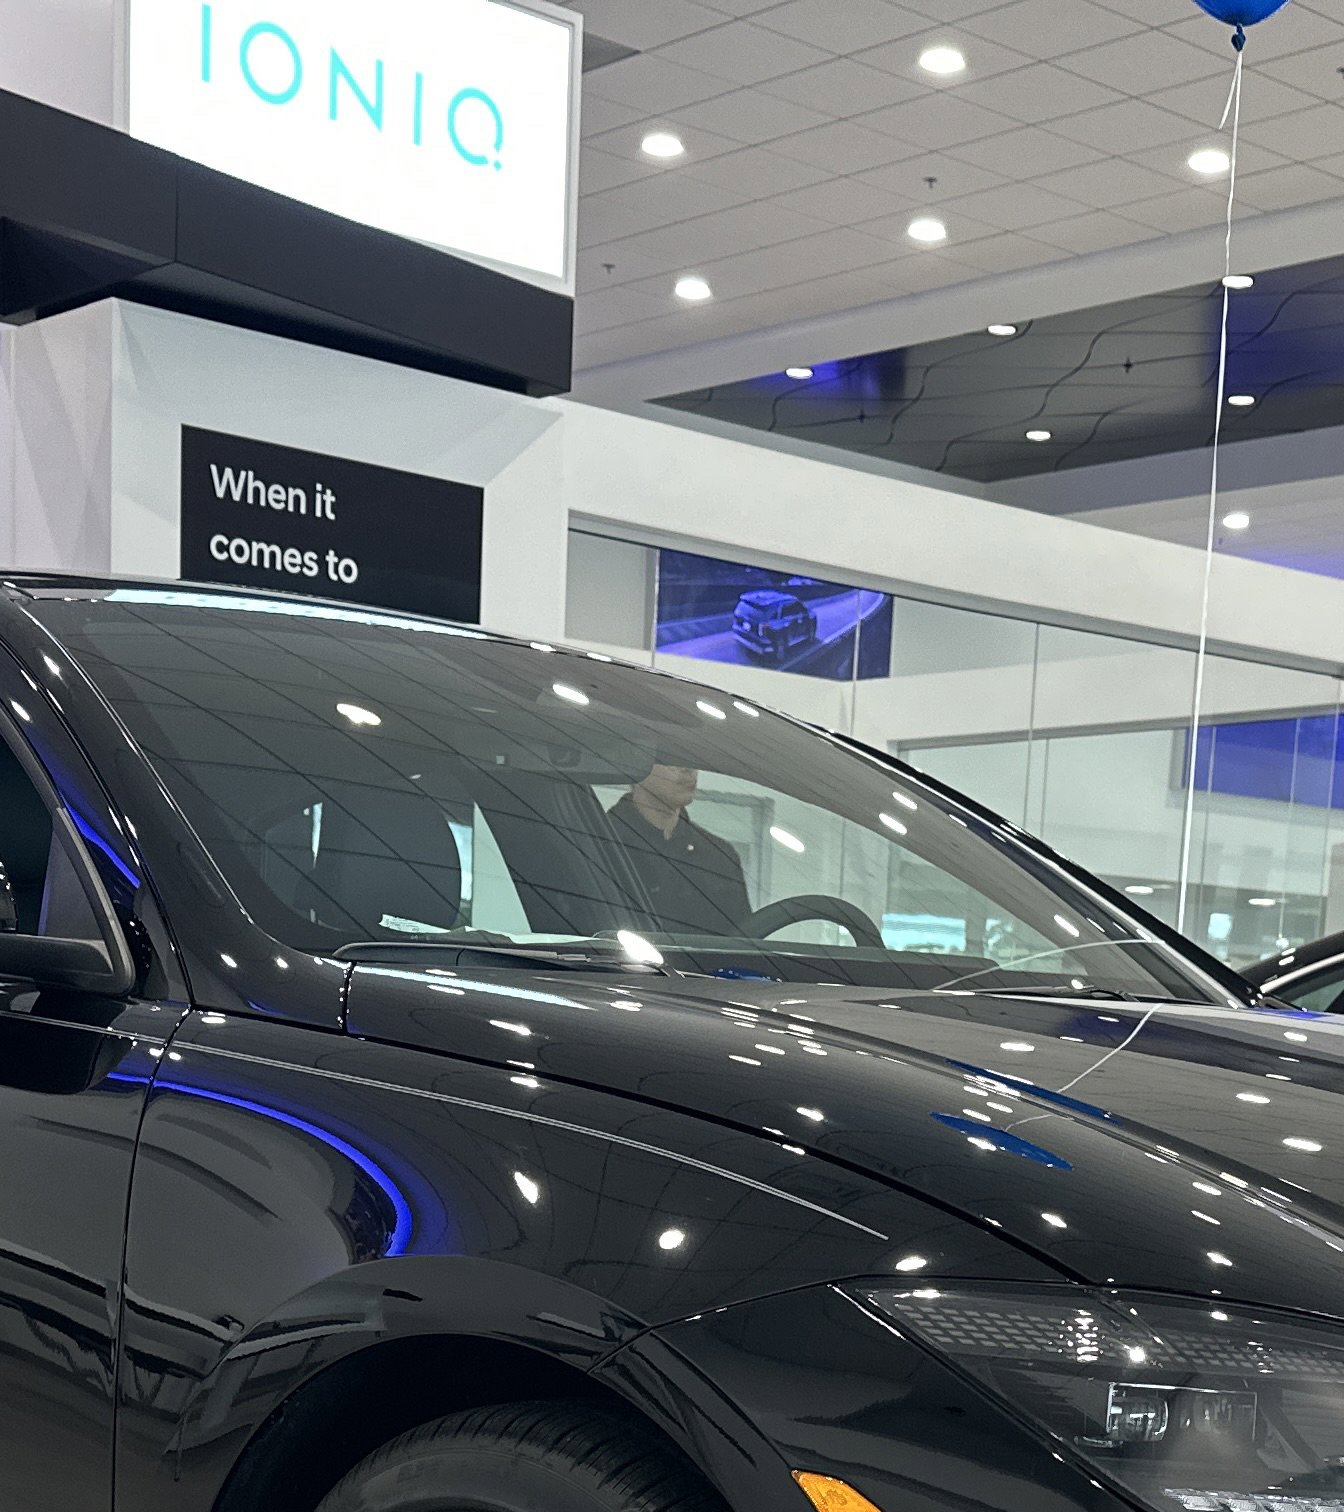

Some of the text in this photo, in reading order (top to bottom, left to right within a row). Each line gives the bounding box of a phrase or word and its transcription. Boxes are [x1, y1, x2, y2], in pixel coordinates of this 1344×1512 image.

[202, 3, 504, 172] IONIQ
[210, 463, 337, 520] When it
[209, 533, 359, 584] comes to
